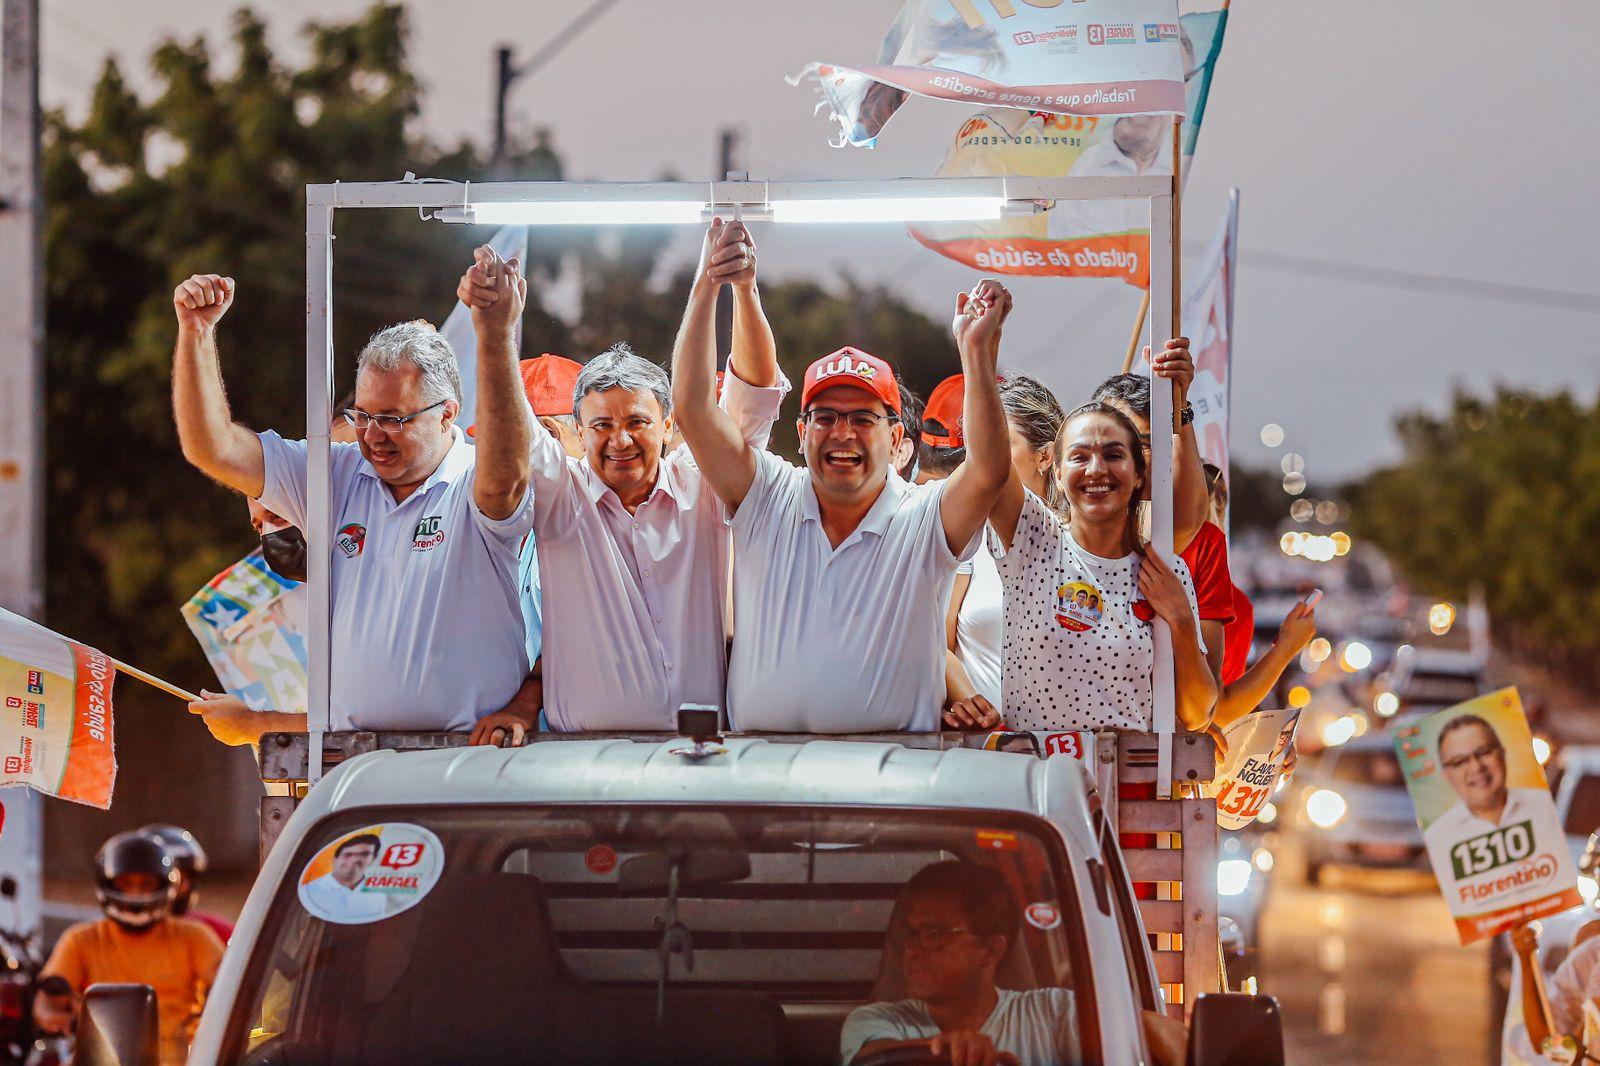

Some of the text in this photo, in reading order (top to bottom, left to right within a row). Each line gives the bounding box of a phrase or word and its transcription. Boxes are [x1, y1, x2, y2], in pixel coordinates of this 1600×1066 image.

[816, 356, 875, 380] LULA
[1050, 734, 1078, 757] 13
[388, 845, 419, 865] 13
[1453, 825, 1533, 877] 1310
[365, 876, 419, 888] RAFAEL
[1459, 864, 1550, 903] Florentino
